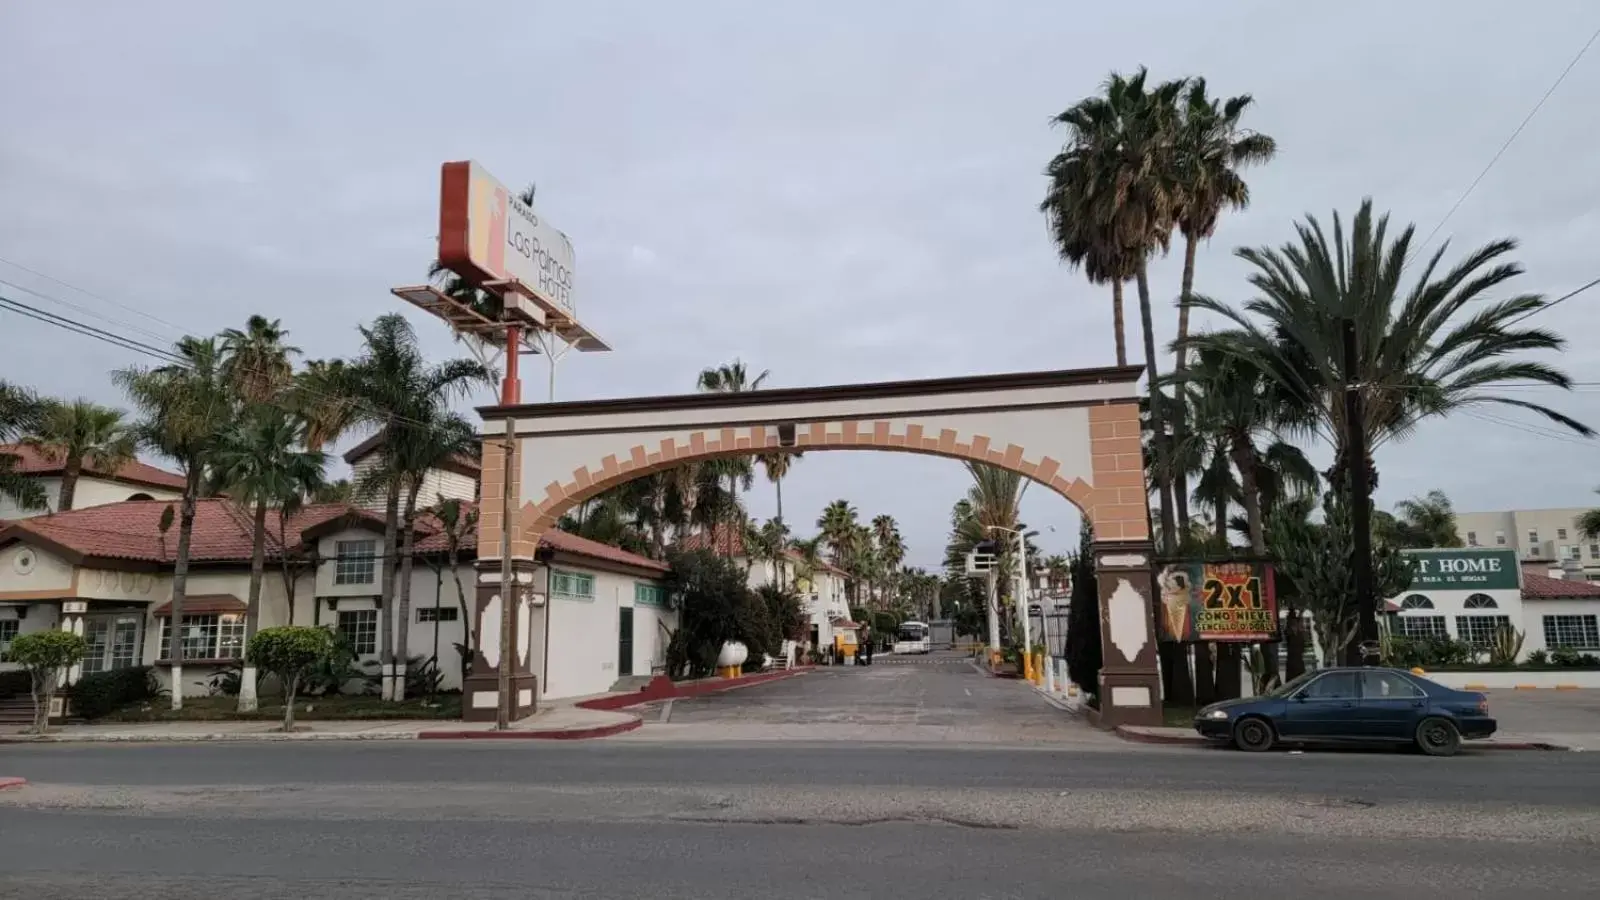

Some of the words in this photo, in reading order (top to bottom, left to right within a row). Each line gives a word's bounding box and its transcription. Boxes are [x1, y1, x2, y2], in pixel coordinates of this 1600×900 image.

[508, 195, 538, 227] PARAISO
[508, 216, 530, 258] Las
[532, 237, 572, 289] Palmas
[539, 270, 572, 310] HOTEL
[1438, 558, 1502, 573] HOME
[1202, 576, 1262, 610] 2x1
[1196, 623, 1236, 631] SENCILLO
[1249, 623, 1275, 631] DOBLE
[1197, 611, 1230, 621] CONO
[1236, 611, 1272, 621] NIEVE
